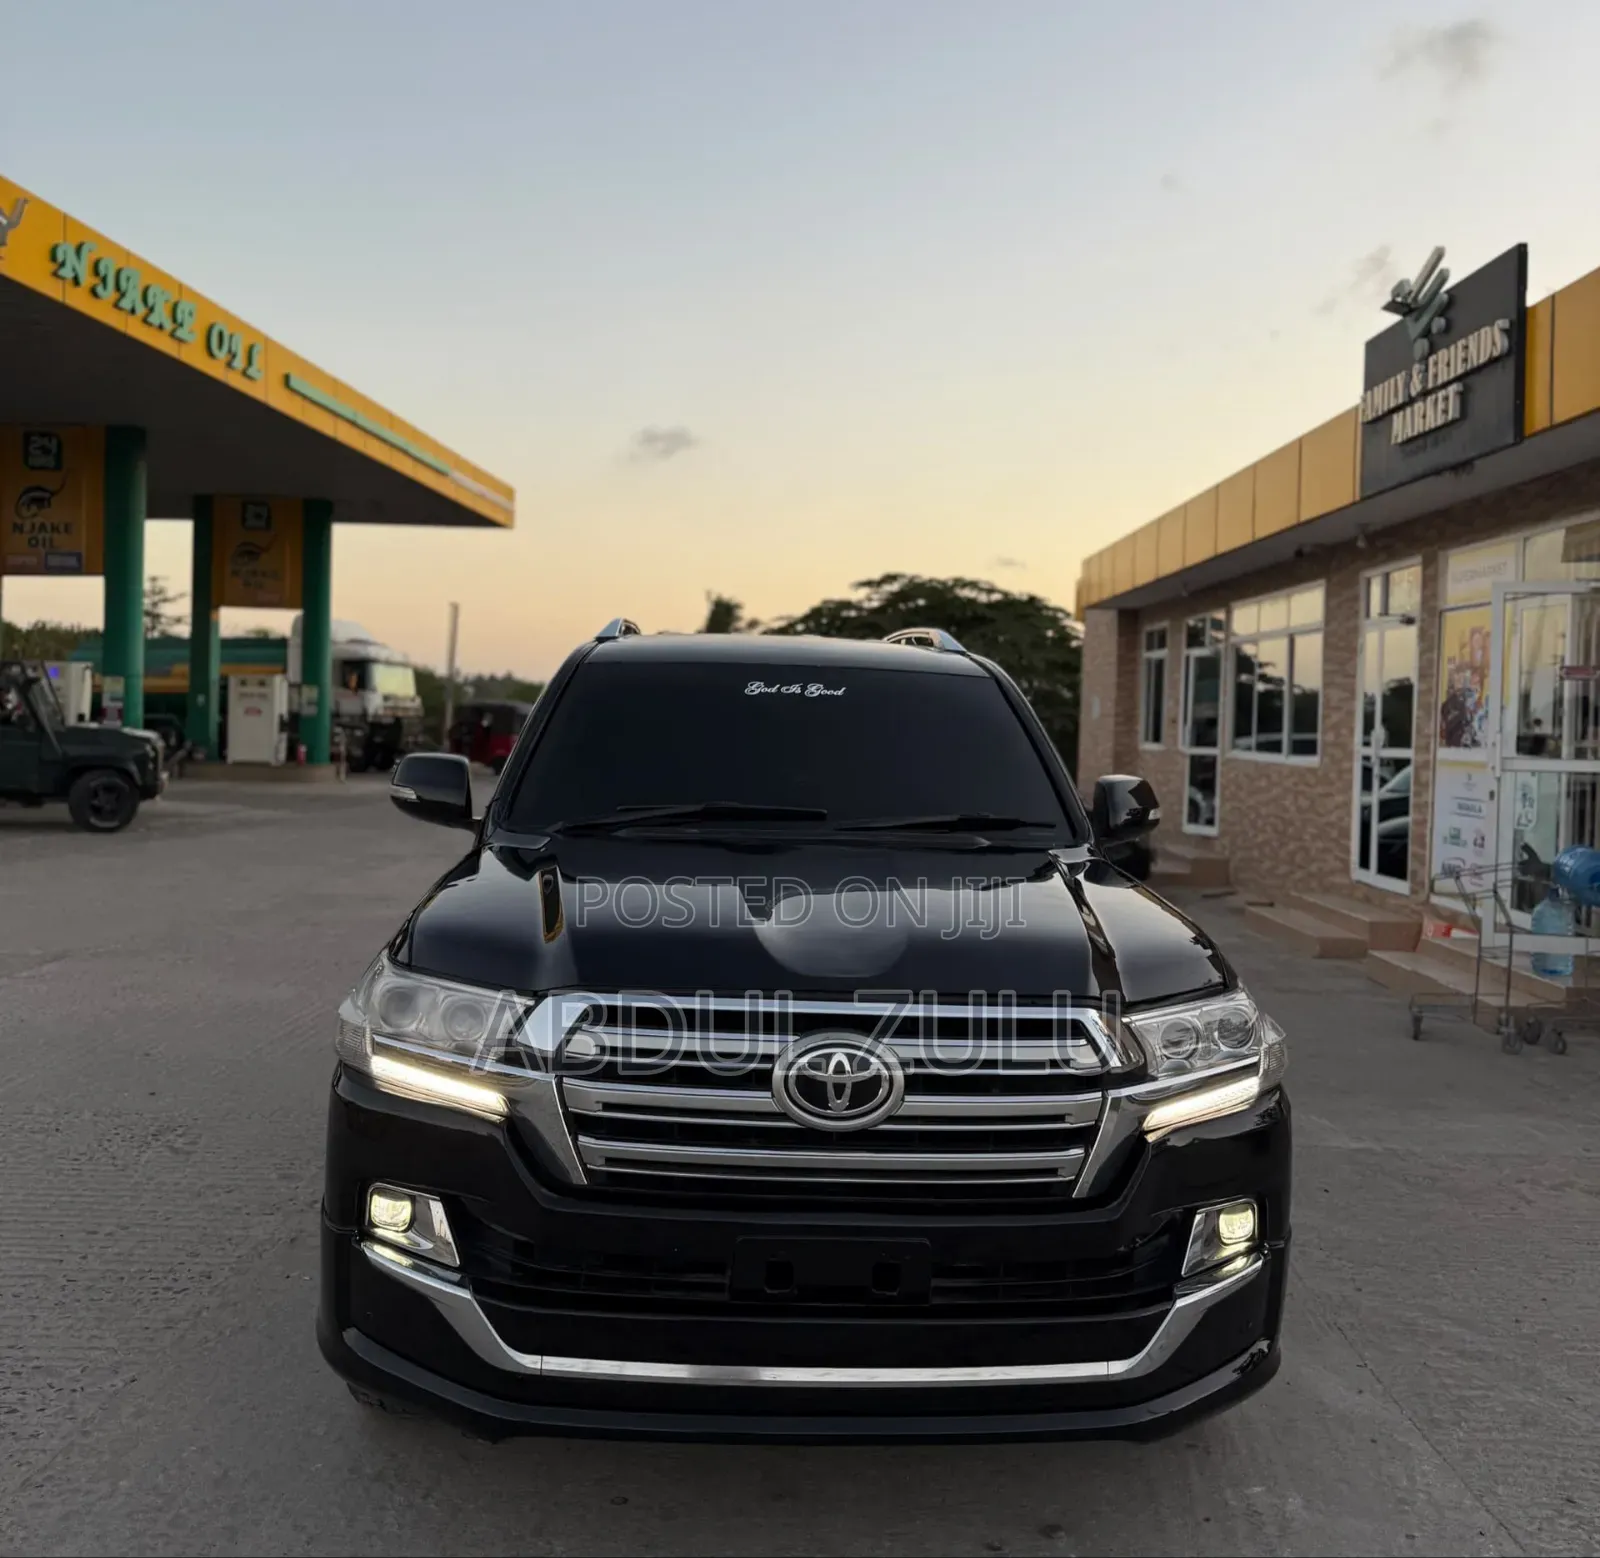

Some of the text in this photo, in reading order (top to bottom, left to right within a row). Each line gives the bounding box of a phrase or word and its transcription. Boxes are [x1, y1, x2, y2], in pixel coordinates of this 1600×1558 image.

[206, 321, 264, 381] OIL
[1410, 362, 1425, 398] &
[1427, 318, 1510, 390] FRIENDS
[1391, 382, 1463, 445] MARKET
[744, 681, 847, 697] God Is Good
